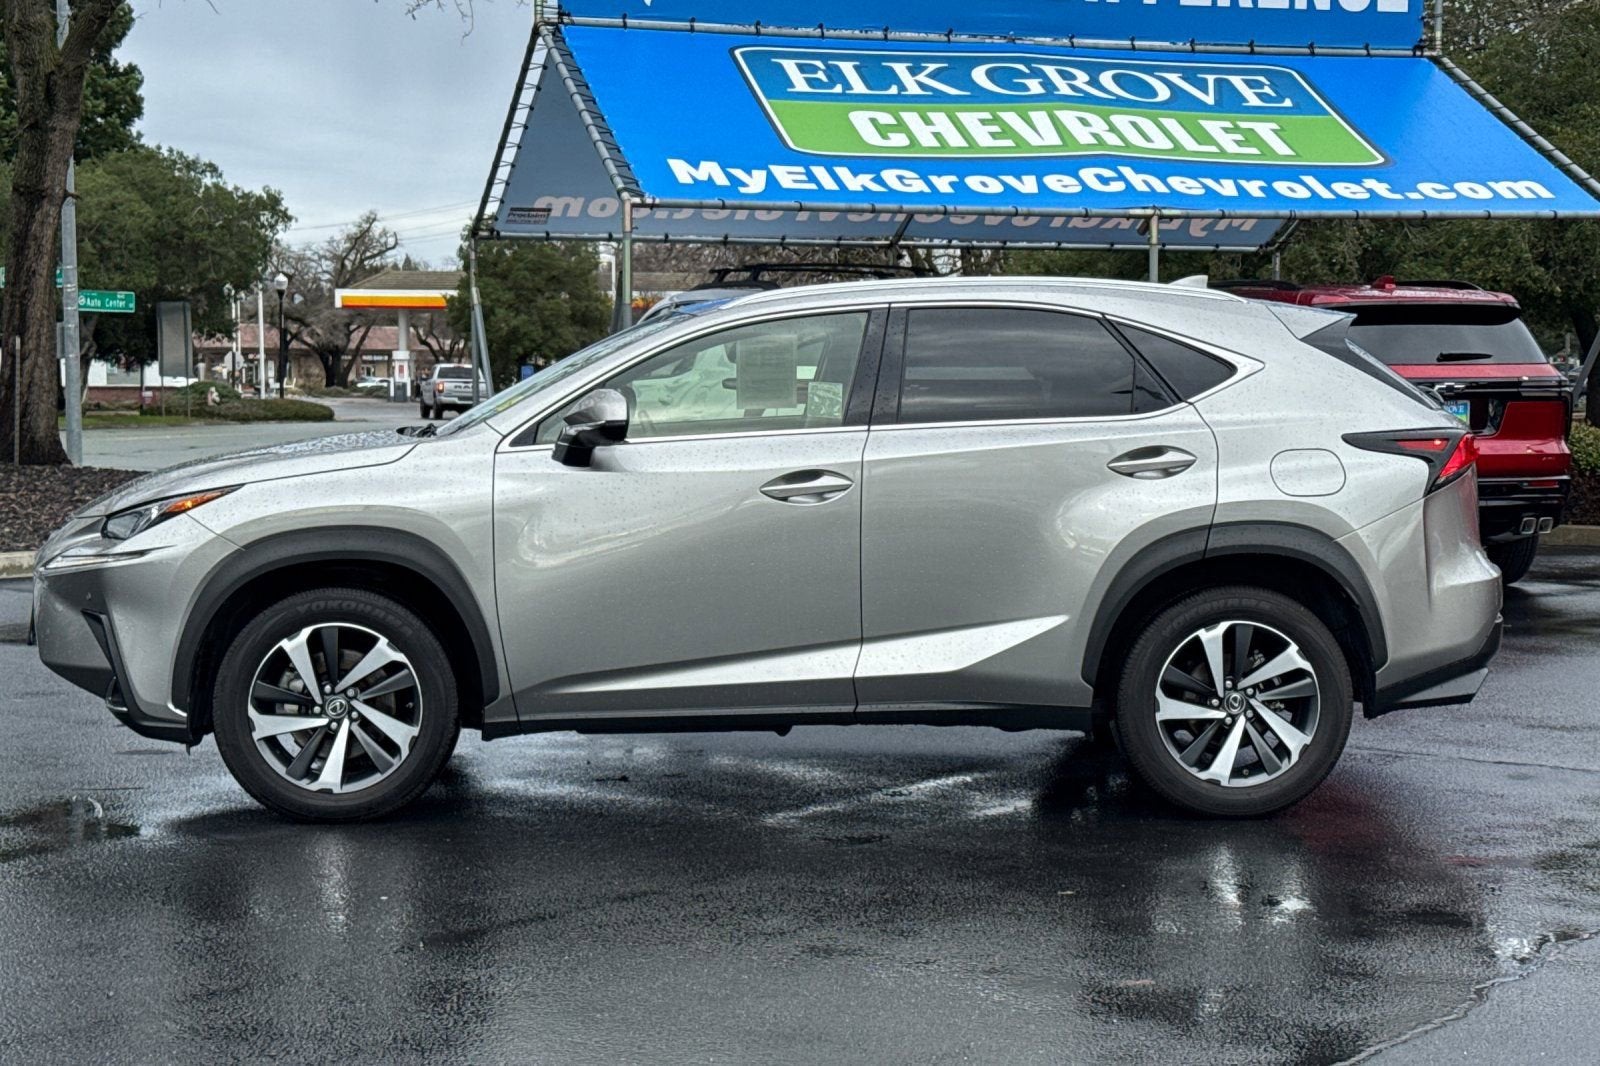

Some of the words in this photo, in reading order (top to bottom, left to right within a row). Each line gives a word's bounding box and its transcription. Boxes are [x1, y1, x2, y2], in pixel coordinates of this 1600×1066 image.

[771, 58, 971, 96] ELK
[971, 62, 1294, 108] GROVE
[848, 110, 1297, 156] CHEVROLET
[666, 158, 1556, 200] MyElkGroveChevrolet.com
[105, 298, 126, 308] Center
